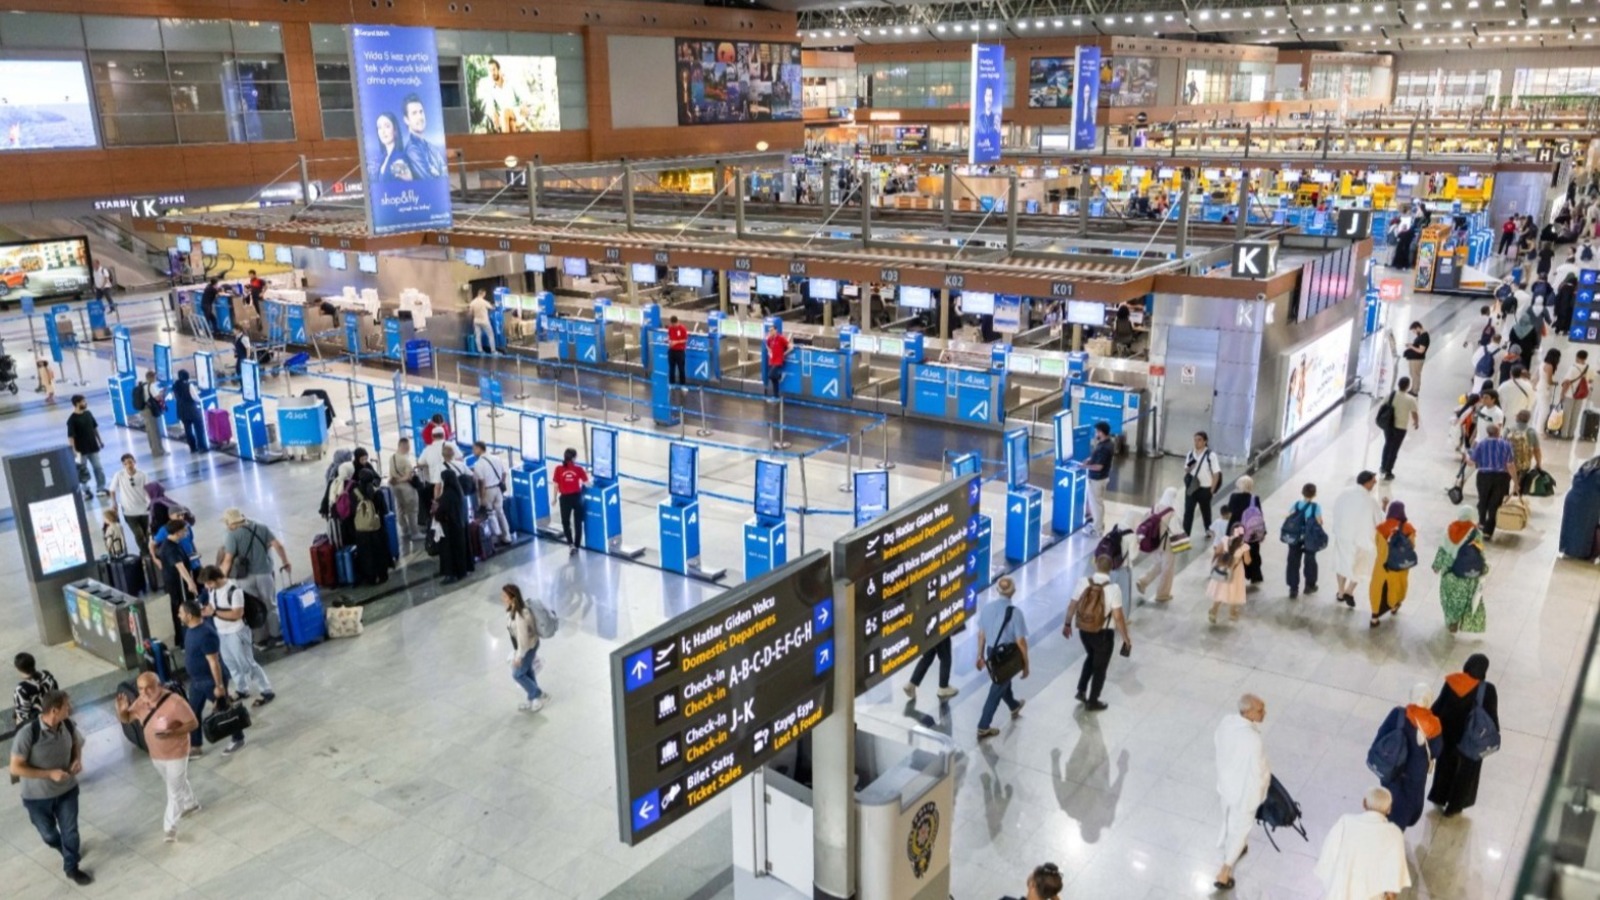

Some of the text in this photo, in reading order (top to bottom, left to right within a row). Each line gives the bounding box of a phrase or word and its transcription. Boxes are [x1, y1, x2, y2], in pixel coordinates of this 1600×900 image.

[364, 64, 434, 74] tek yön uçak bileti
[384, 52, 390, 61] 5
[366, 76, 386, 85] alma
[1540, 149, 1551, 162] H
[1560, 143, 1570, 155] G
[130, 199, 140, 218] K
[142, 200, 159, 217] K
[1346, 212, 1359, 235] J
[606, 248, 619, 259] K07
[655, 252, 668, 263] K06
[736, 259, 751, 270] K05
[1238, 246, 1261, 274] K
[790, 262, 806, 273] K04
[881, 270, 899, 282] K03
[945, 275, 964, 287] K02
[1053, 284, 1073, 296] K01
[1236, 302, 1253, 327] K
[883, 514, 955, 560] International Departures
[896, 522, 916, 539] Hatlar
[916, 512, 934, 528] Giden
[882, 563, 904, 585] Engelli
[904, 557, 920, 572] Yolcu
[948, 526, 968, 546] Check-in
[882, 575, 909, 600] Disabled
[910, 560, 941, 585] Information
[946, 542, 967, 562] Check-in
[940, 578, 961, 601] First Aid
[681, 596, 776, 655] İç Hatlar Giden Yolcu
[882, 603, 906, 623] Eczane
[882, 612, 914, 638] Pharmacy
[682, 614, 777, 672] Domestic Departures
[684, 620, 813, 699] Check-in A-B-C-D-E-F-G-H
[882, 644, 919, 675] Information
[684, 686, 727, 718] Check-in
[686, 696, 756, 745] Check-in J-K
[774, 700, 814, 735] Kayıp Eşya
[774, 706, 823, 751] Lost & Found
[686, 731, 728, 763] Check-in
[686, 752, 735, 791] Bilet Satış
[686, 764, 743, 807] Ticket Sales
